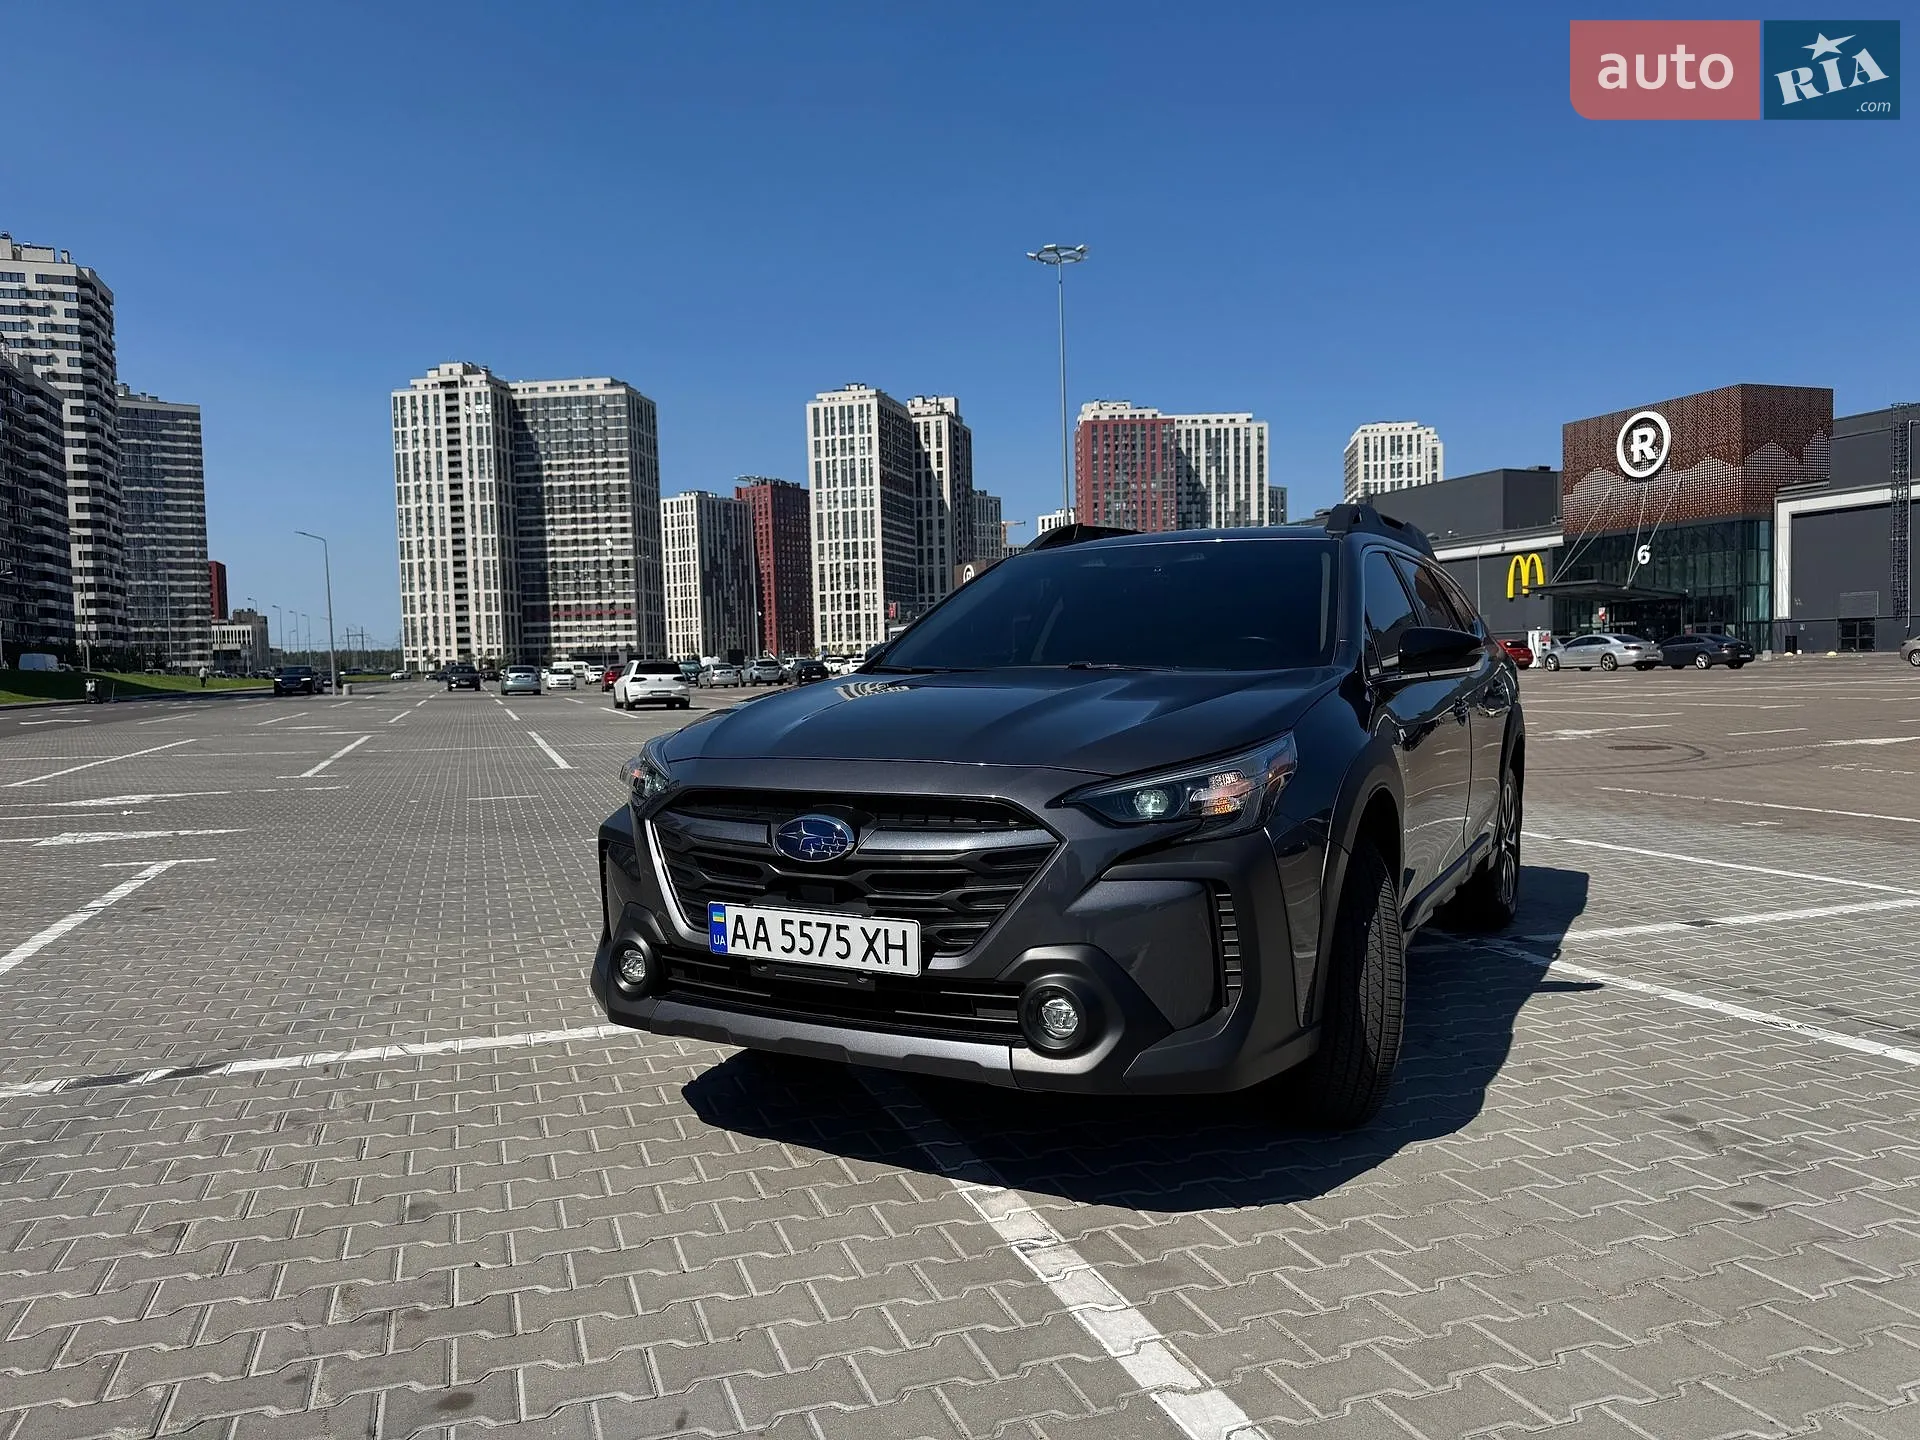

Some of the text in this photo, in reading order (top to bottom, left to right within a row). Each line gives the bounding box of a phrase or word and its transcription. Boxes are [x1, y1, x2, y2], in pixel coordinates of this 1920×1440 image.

[1637, 544, 1651, 565] 6
[713, 934, 726, 946] UA
[731, 914, 908, 967] AA 5575 XH
